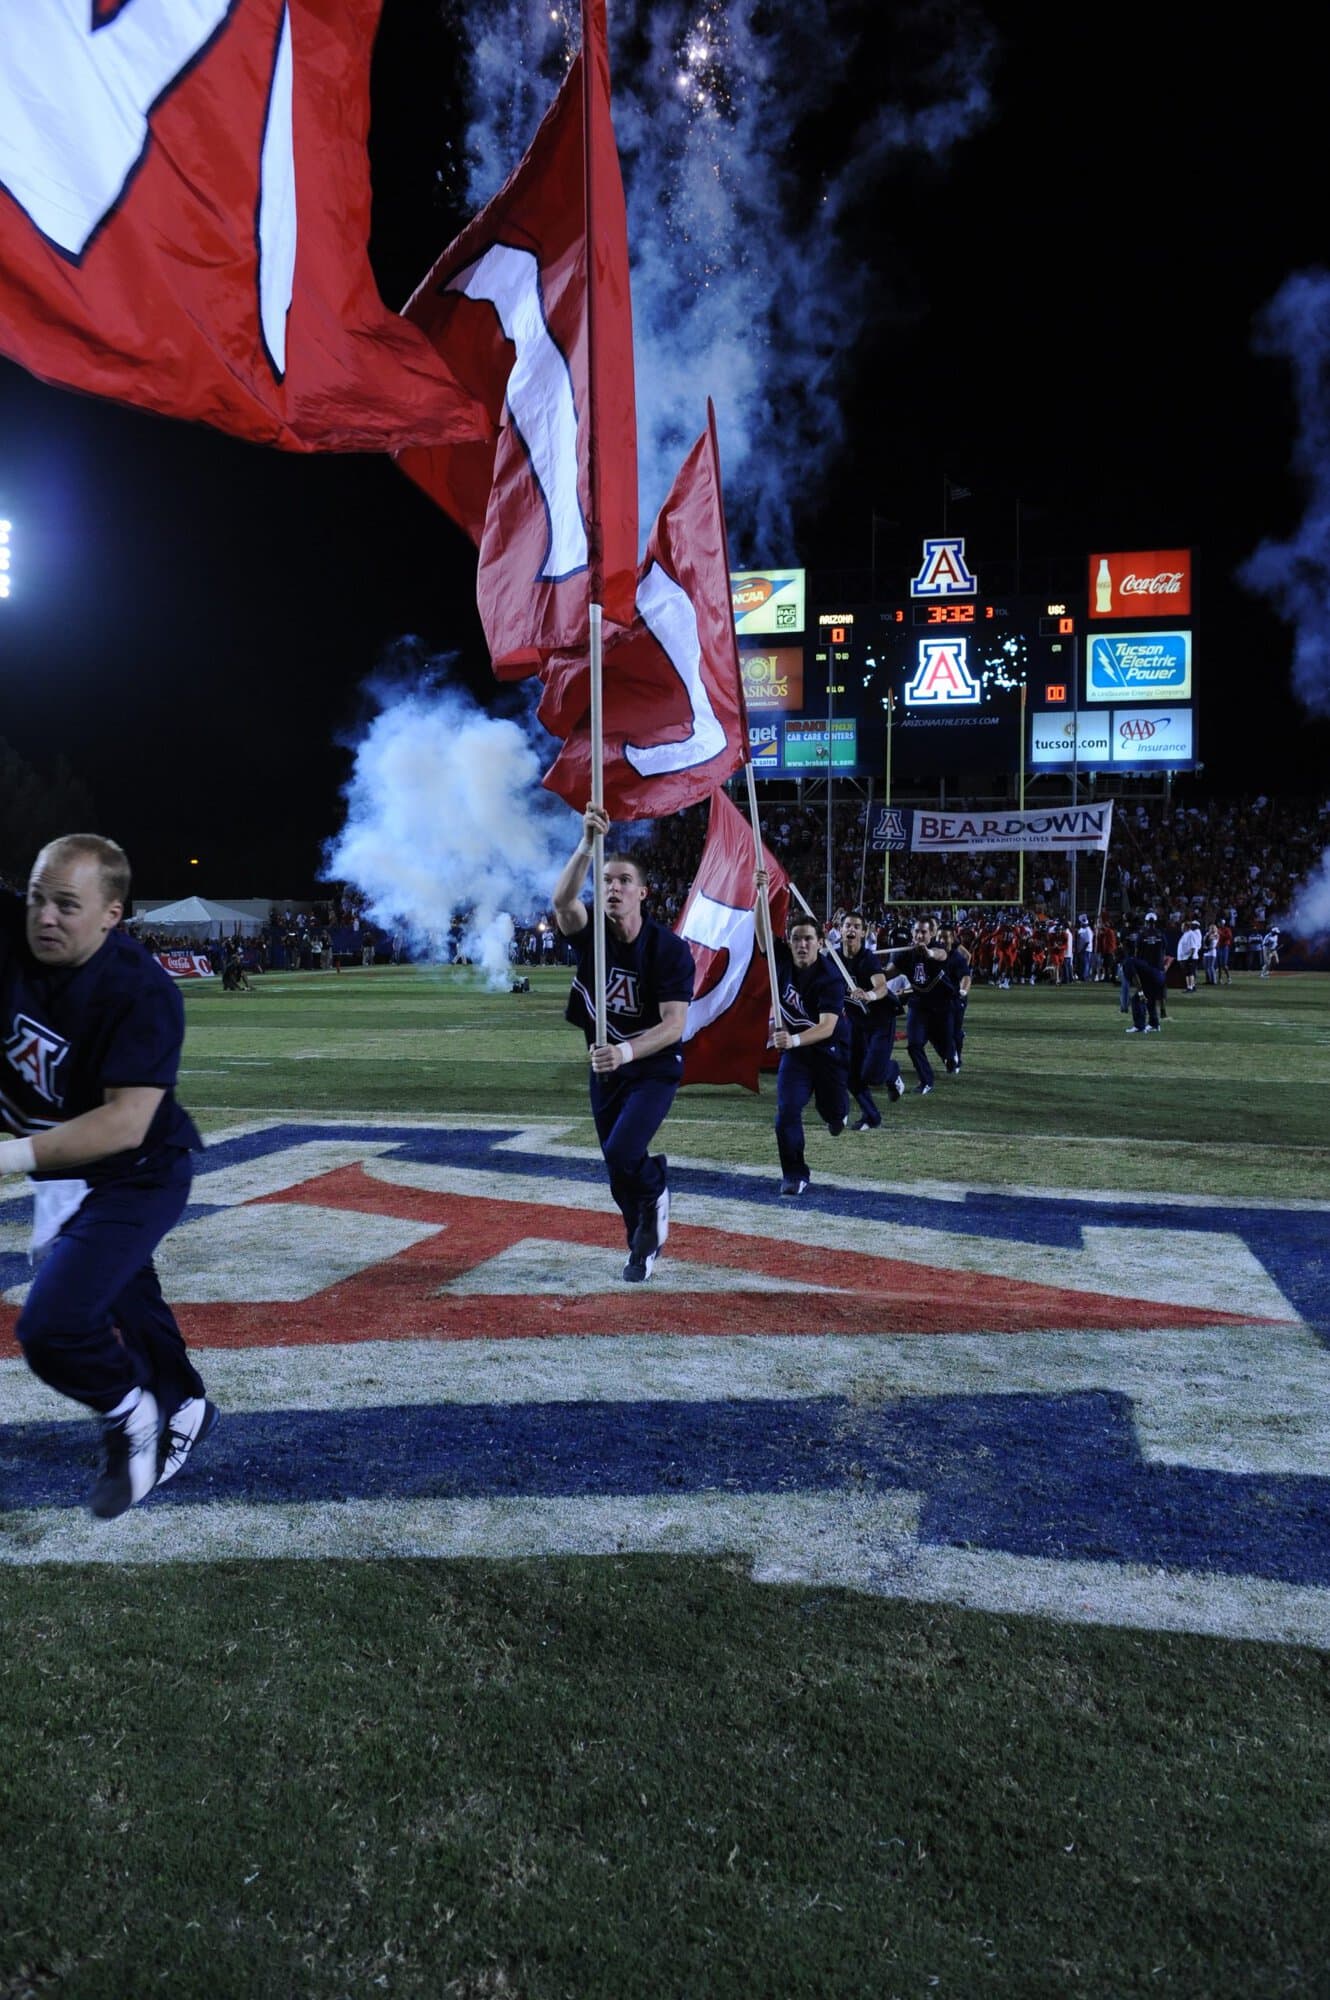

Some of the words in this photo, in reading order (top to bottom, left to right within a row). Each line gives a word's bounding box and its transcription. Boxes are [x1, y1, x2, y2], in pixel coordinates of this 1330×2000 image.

[910, 537, 977, 597] A
[1119, 573, 1184, 595] Coca-Cola
[732, 590, 764, 605] NCAA
[896, 611, 904, 622] 3
[927, 605, 974, 624] 3:32
[985, 607, 994, 618] 3
[1047, 604, 1066, 615] USC
[819, 614, 853, 625] ARIZONA
[832, 628, 845, 642] 0
[1115, 643, 1164, 657] Tucson
[1120, 654, 1177, 668] Electric
[905, 638, 981, 706] A
[1125, 667, 1176, 681] Power
[824, 731, 854, 741] CNTERS
[1121, 719, 1155, 740] AAA
[1035, 738, 1107, 750] tucson.com
[1137, 743, 1187, 752] Insurance
[873, 808, 907, 841] A
[605, 967, 643, 1017] A
[2, 1012, 71, 1109] A
